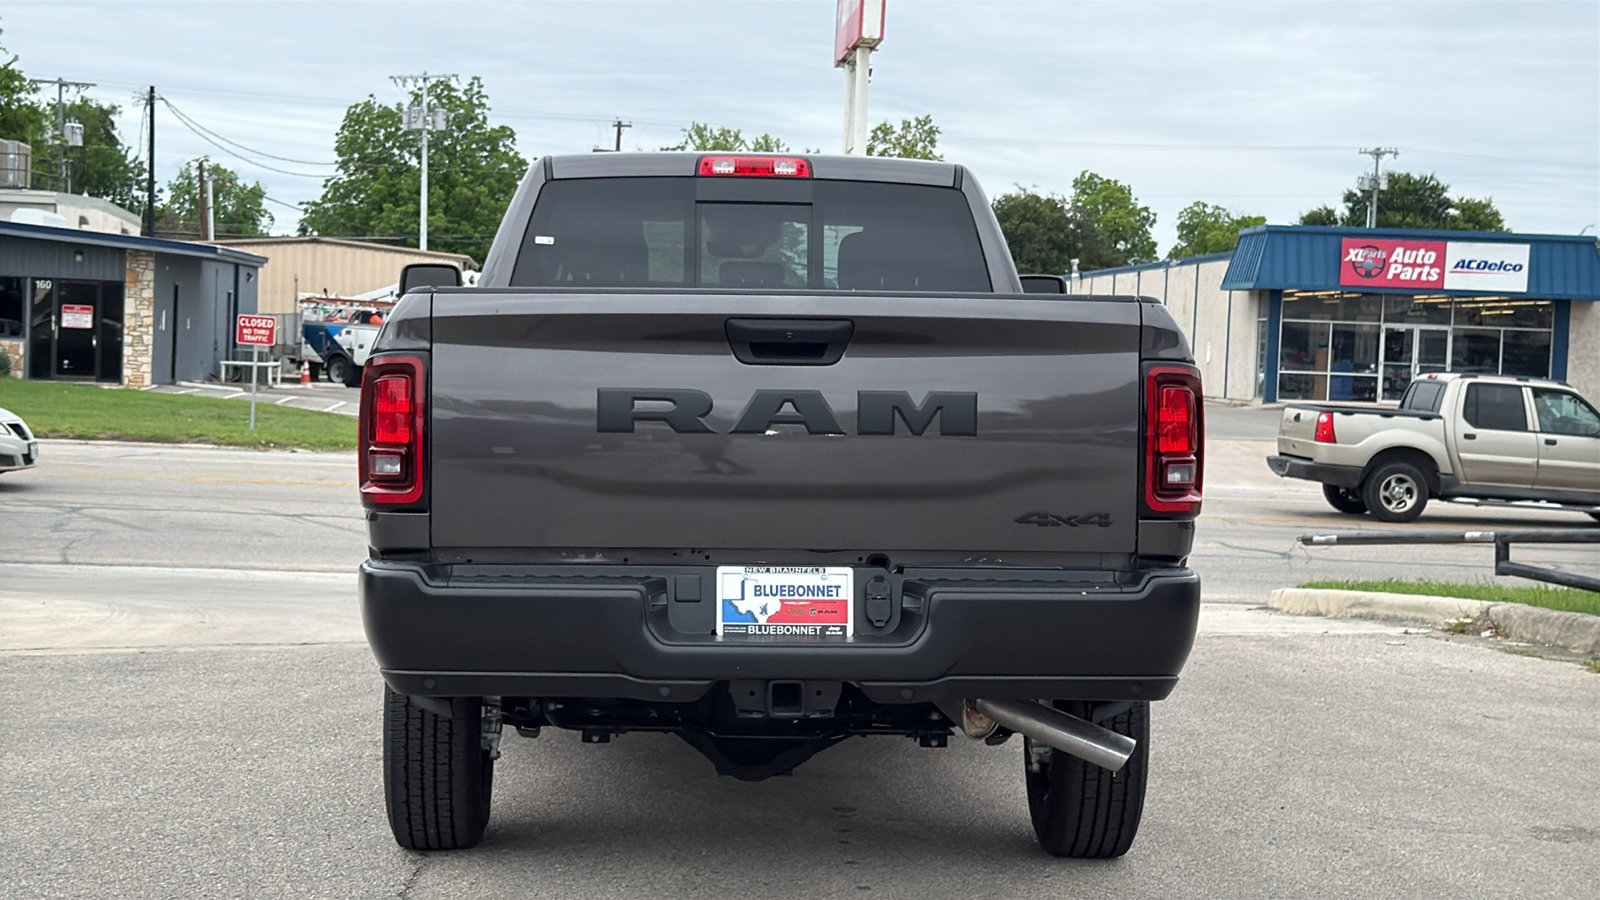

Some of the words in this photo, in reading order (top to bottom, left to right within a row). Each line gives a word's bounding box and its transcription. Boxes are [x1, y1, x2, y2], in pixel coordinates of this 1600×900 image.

[1389, 247, 1437, 265] Auto
[1453, 258, 1523, 273] ACDelco
[1386, 265, 1440, 282] Parts
[239, 317, 274, 328] CLOSED
[243, 334, 269, 342] TRAFFIC
[597, 387, 978, 437] RAM
[753, 584, 841, 598] BLUEBONNET
[748, 625, 823, 636] BLUEBONNET
